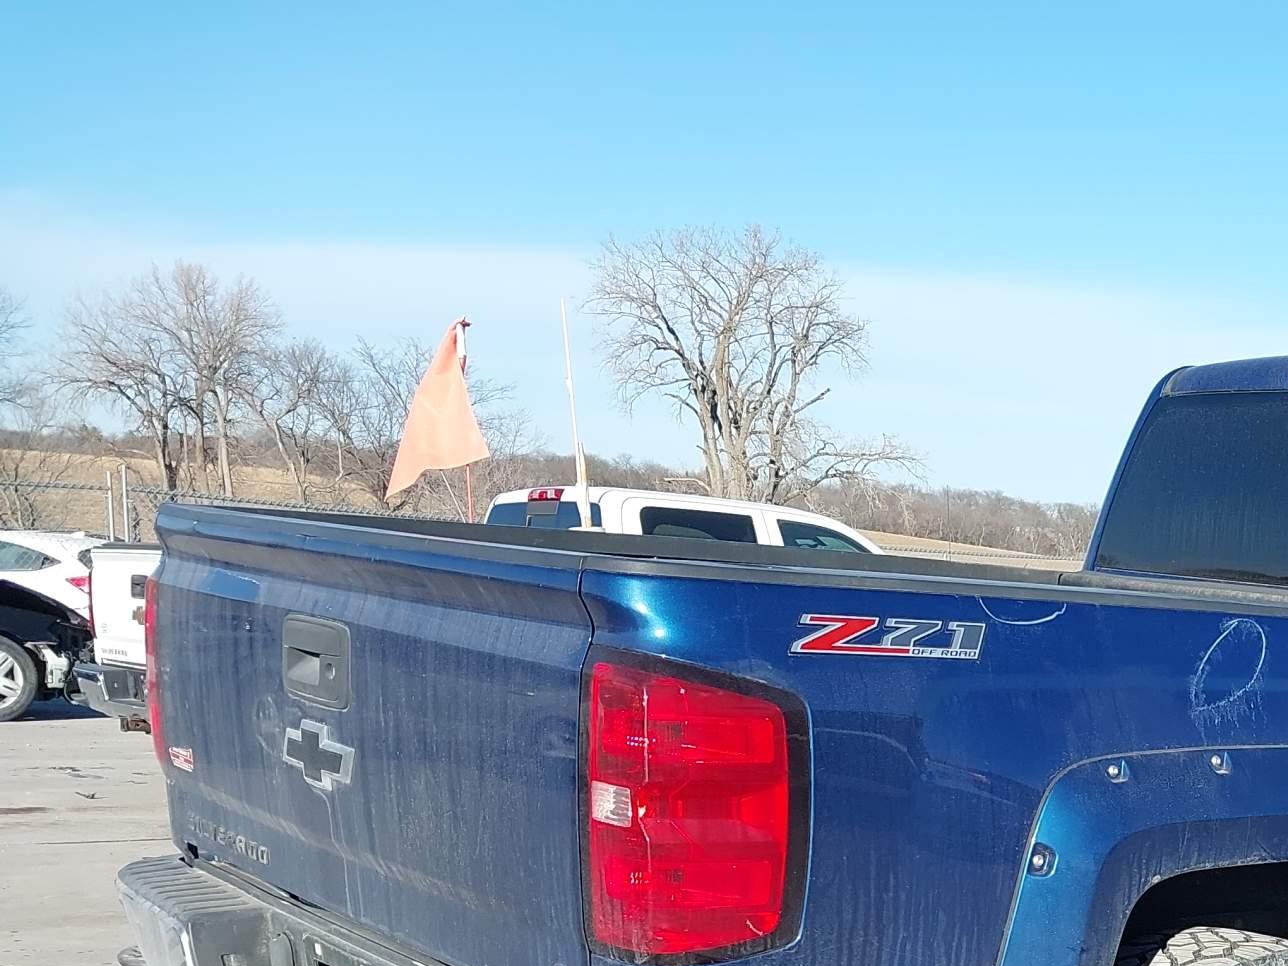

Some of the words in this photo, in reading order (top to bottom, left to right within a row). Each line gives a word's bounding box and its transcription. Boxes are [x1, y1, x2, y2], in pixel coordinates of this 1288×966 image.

[789, 613, 986, 654] Z71
[911, 648, 937, 656] OFF
[940, 650, 978, 658] ROAD
